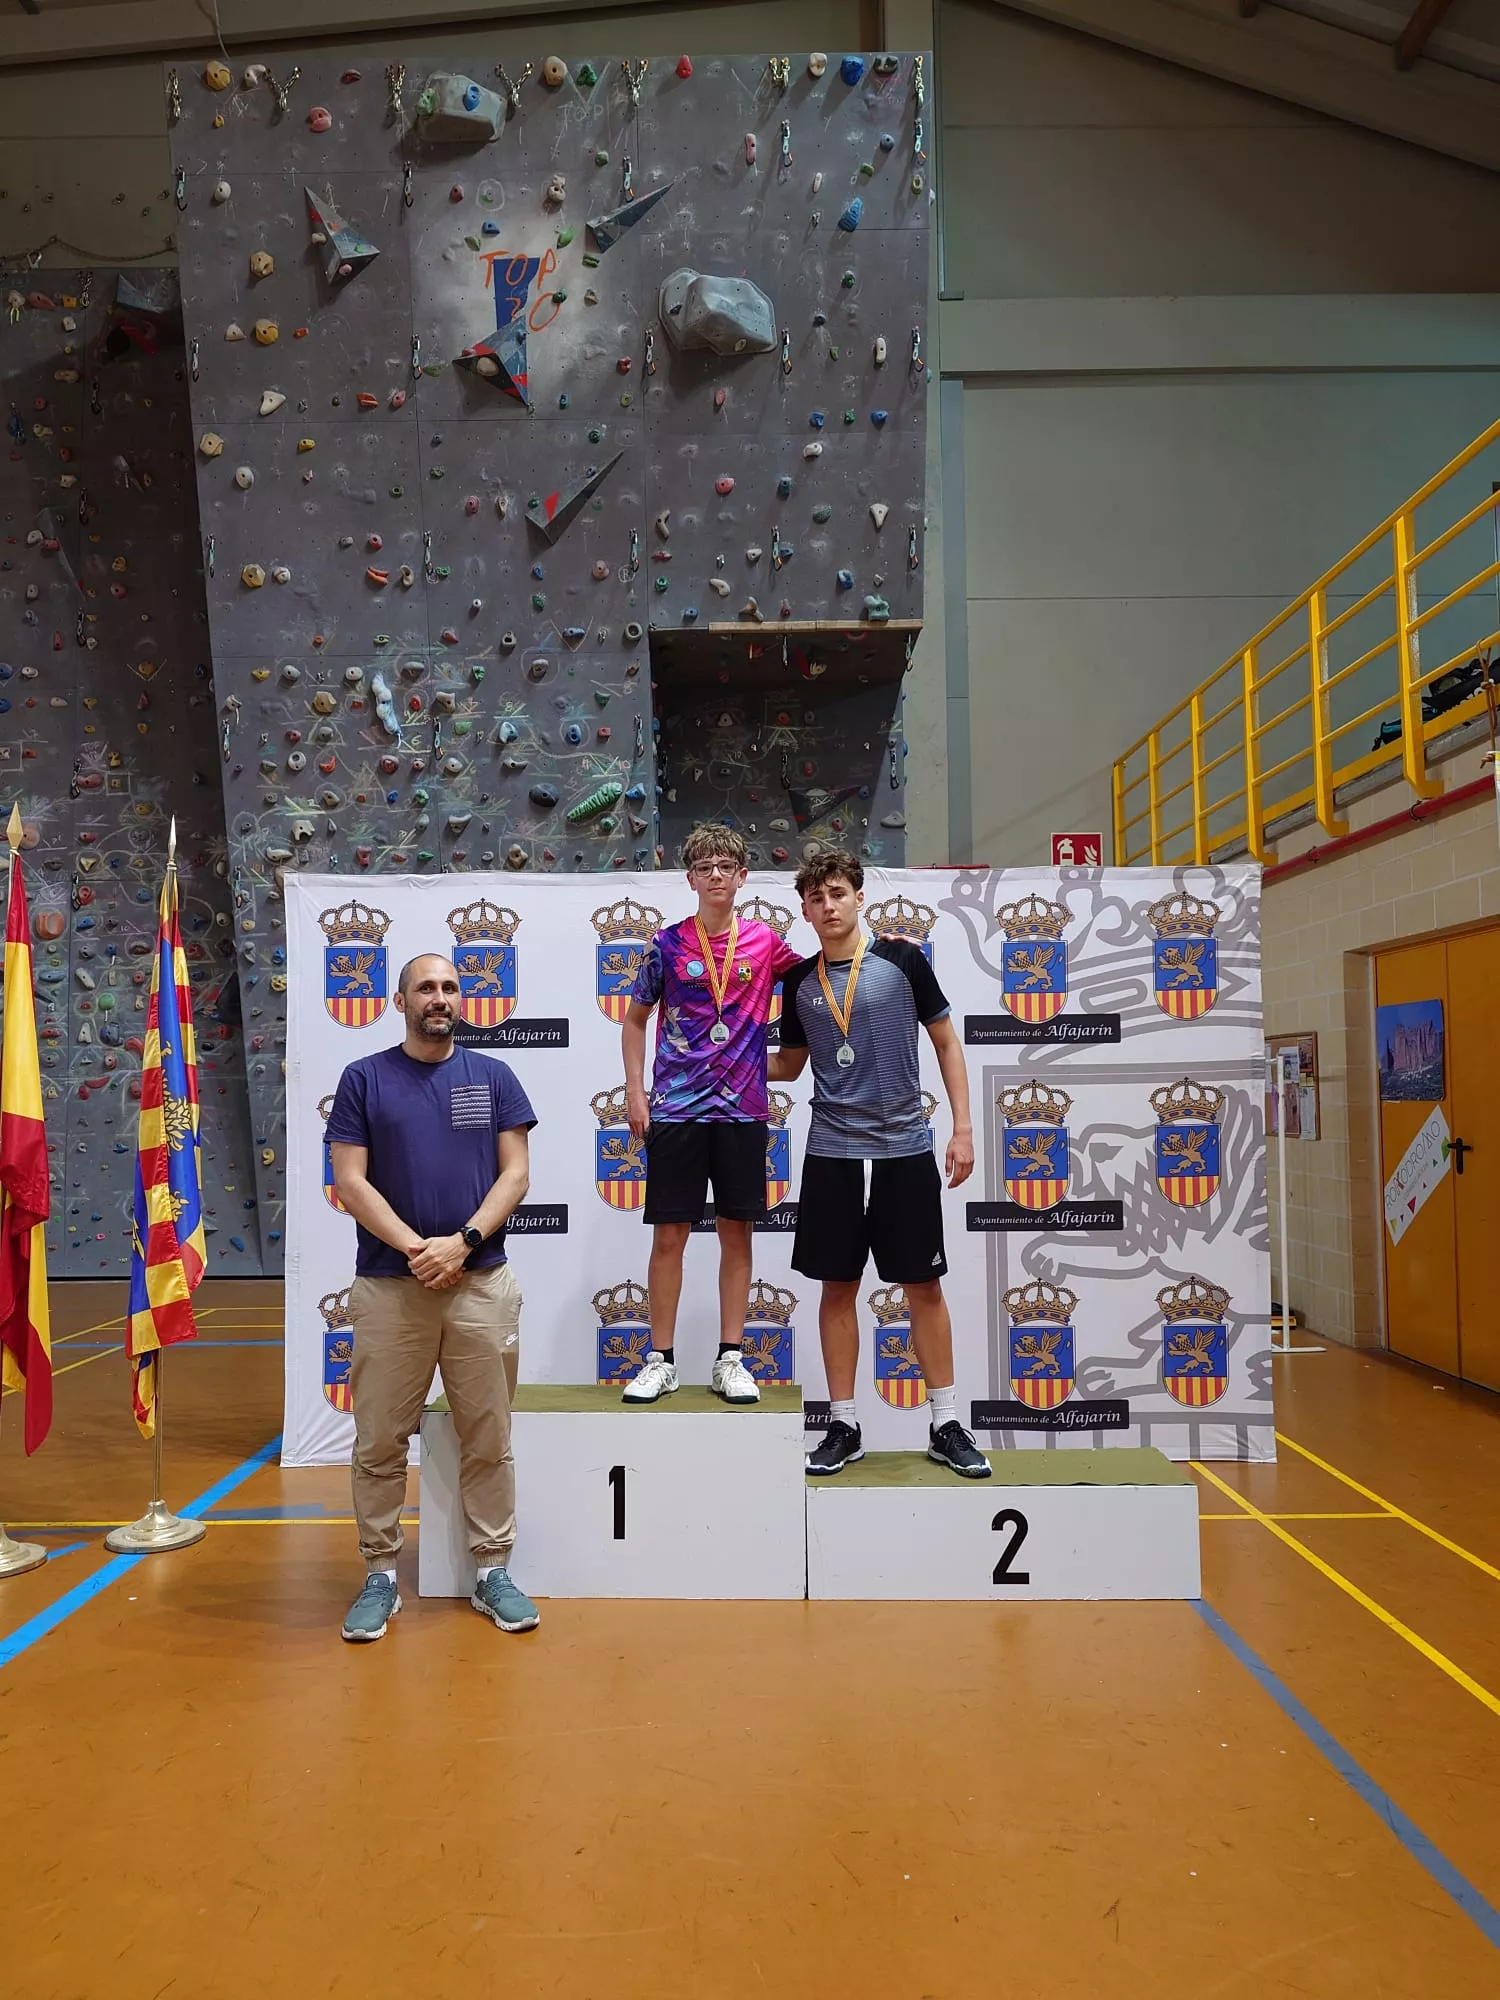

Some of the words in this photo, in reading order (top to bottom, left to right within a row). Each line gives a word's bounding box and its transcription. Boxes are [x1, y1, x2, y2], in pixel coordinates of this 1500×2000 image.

[480, 248, 556, 290] TOP
[812, 996, 823, 1006] FZ
[482, 1033, 491, 1041] de
[494, 1028, 561, 1045] Alfajarín
[971, 1030, 1031, 1040] Ayuntamiento
[1032, 1029, 1042, 1037] de
[1045, 1023, 1113, 1040] Alfajarín
[506, 1213, 561, 1231] lfajarín
[973, 1216, 1033, 1226] Ayuntamiento
[1034, 1216, 1044, 1224] de
[1047, 1210, 1116, 1228] Alfajarín
[977, 1415, 1038, 1425] Ayuntamiento
[1039, 1415, 1050, 1424] de
[1052, 1409, 1121, 1428] Alfajarín
[608, 1465, 626, 1540] 1
[991, 1508, 1030, 1585] 2
